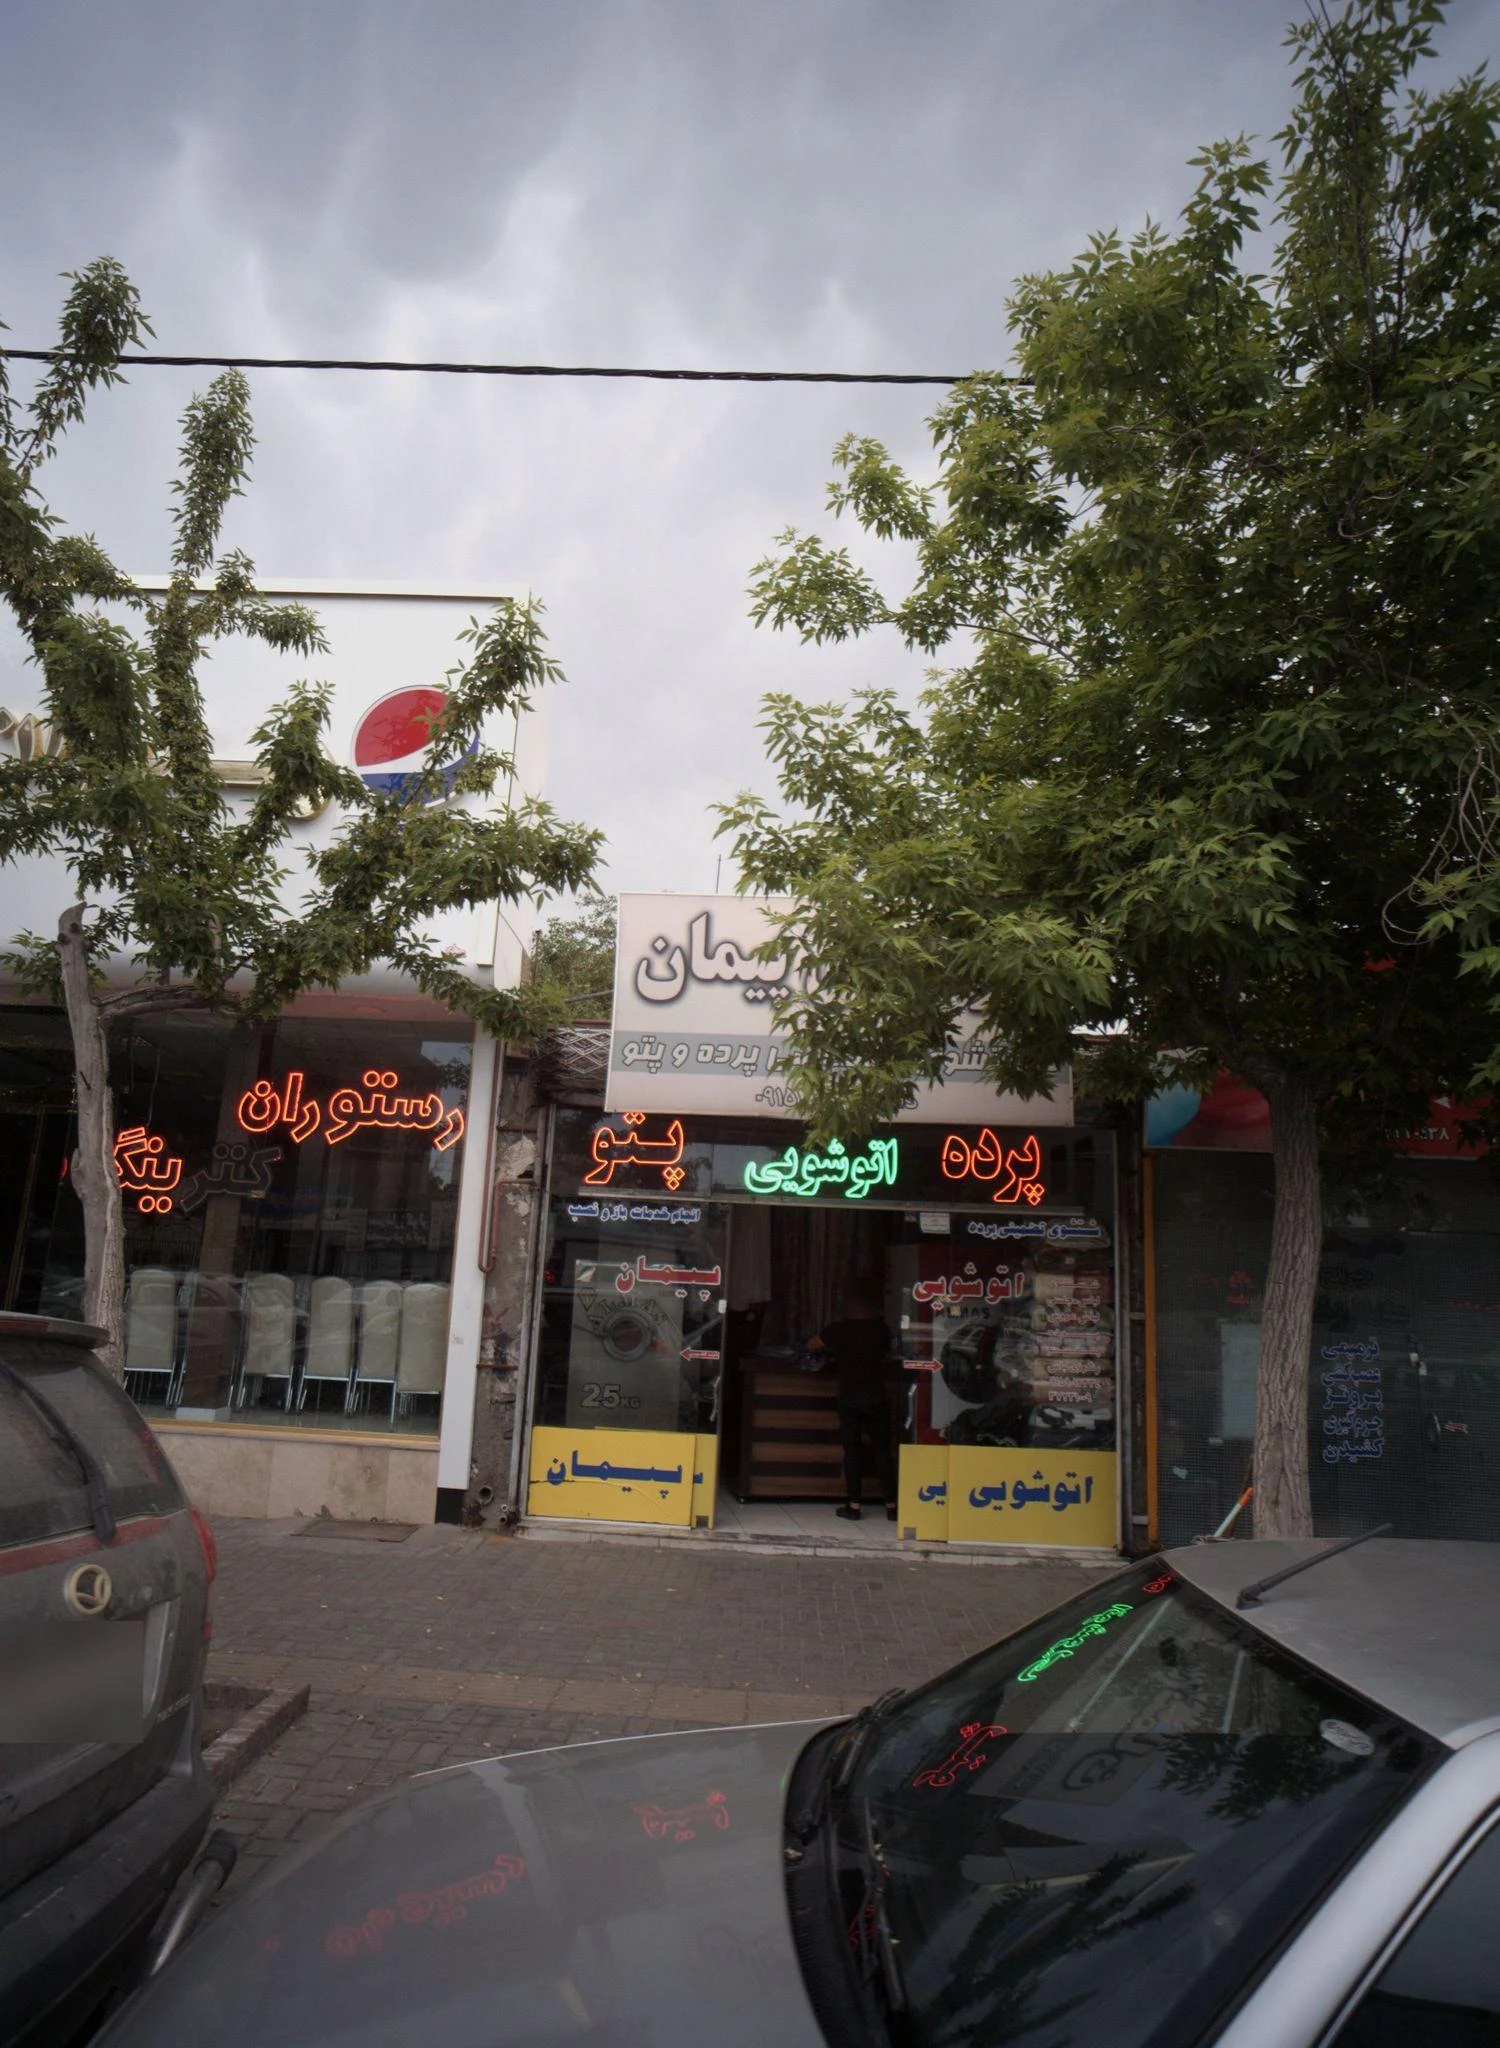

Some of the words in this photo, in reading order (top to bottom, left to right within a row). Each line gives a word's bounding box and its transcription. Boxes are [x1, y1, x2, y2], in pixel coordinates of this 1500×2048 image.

[634, 911, 795, 1006] پیمان
[621, 1036, 667, 1074] پتو
[671, 1041, 691, 1068] و
[697, 1040, 760, 1077] پرده
[238, 1070, 466, 1152] رستوران
[583, 1112, 686, 1191] پتو
[743, 1136, 899, 1199] اتوشویی
[941, 1127, 1046, 1207] پرده
[567, 1201, 600, 1222] نصب
[629, 1206, 672, 1222] خدمات
[670, 1206, 701, 1225] انجام
[967, 1220, 998, 1241] پرده
[998, 1221, 1047, 1240] تضمینی
[615, 1253, 722, 1302] پیمان
[1320, 1336, 1381, 1362] ترمیمی
[579, 1382, 622, 1410] 25
[620, 1395, 641, 1408] KG
[1322, 1384, 1384, 1412] پروتز
[1321, 1437, 1386, 1464] کشیدن
[547, 1450, 683, 1500] پیمان
[967, 1469, 1095, 1513] اتوشویی
